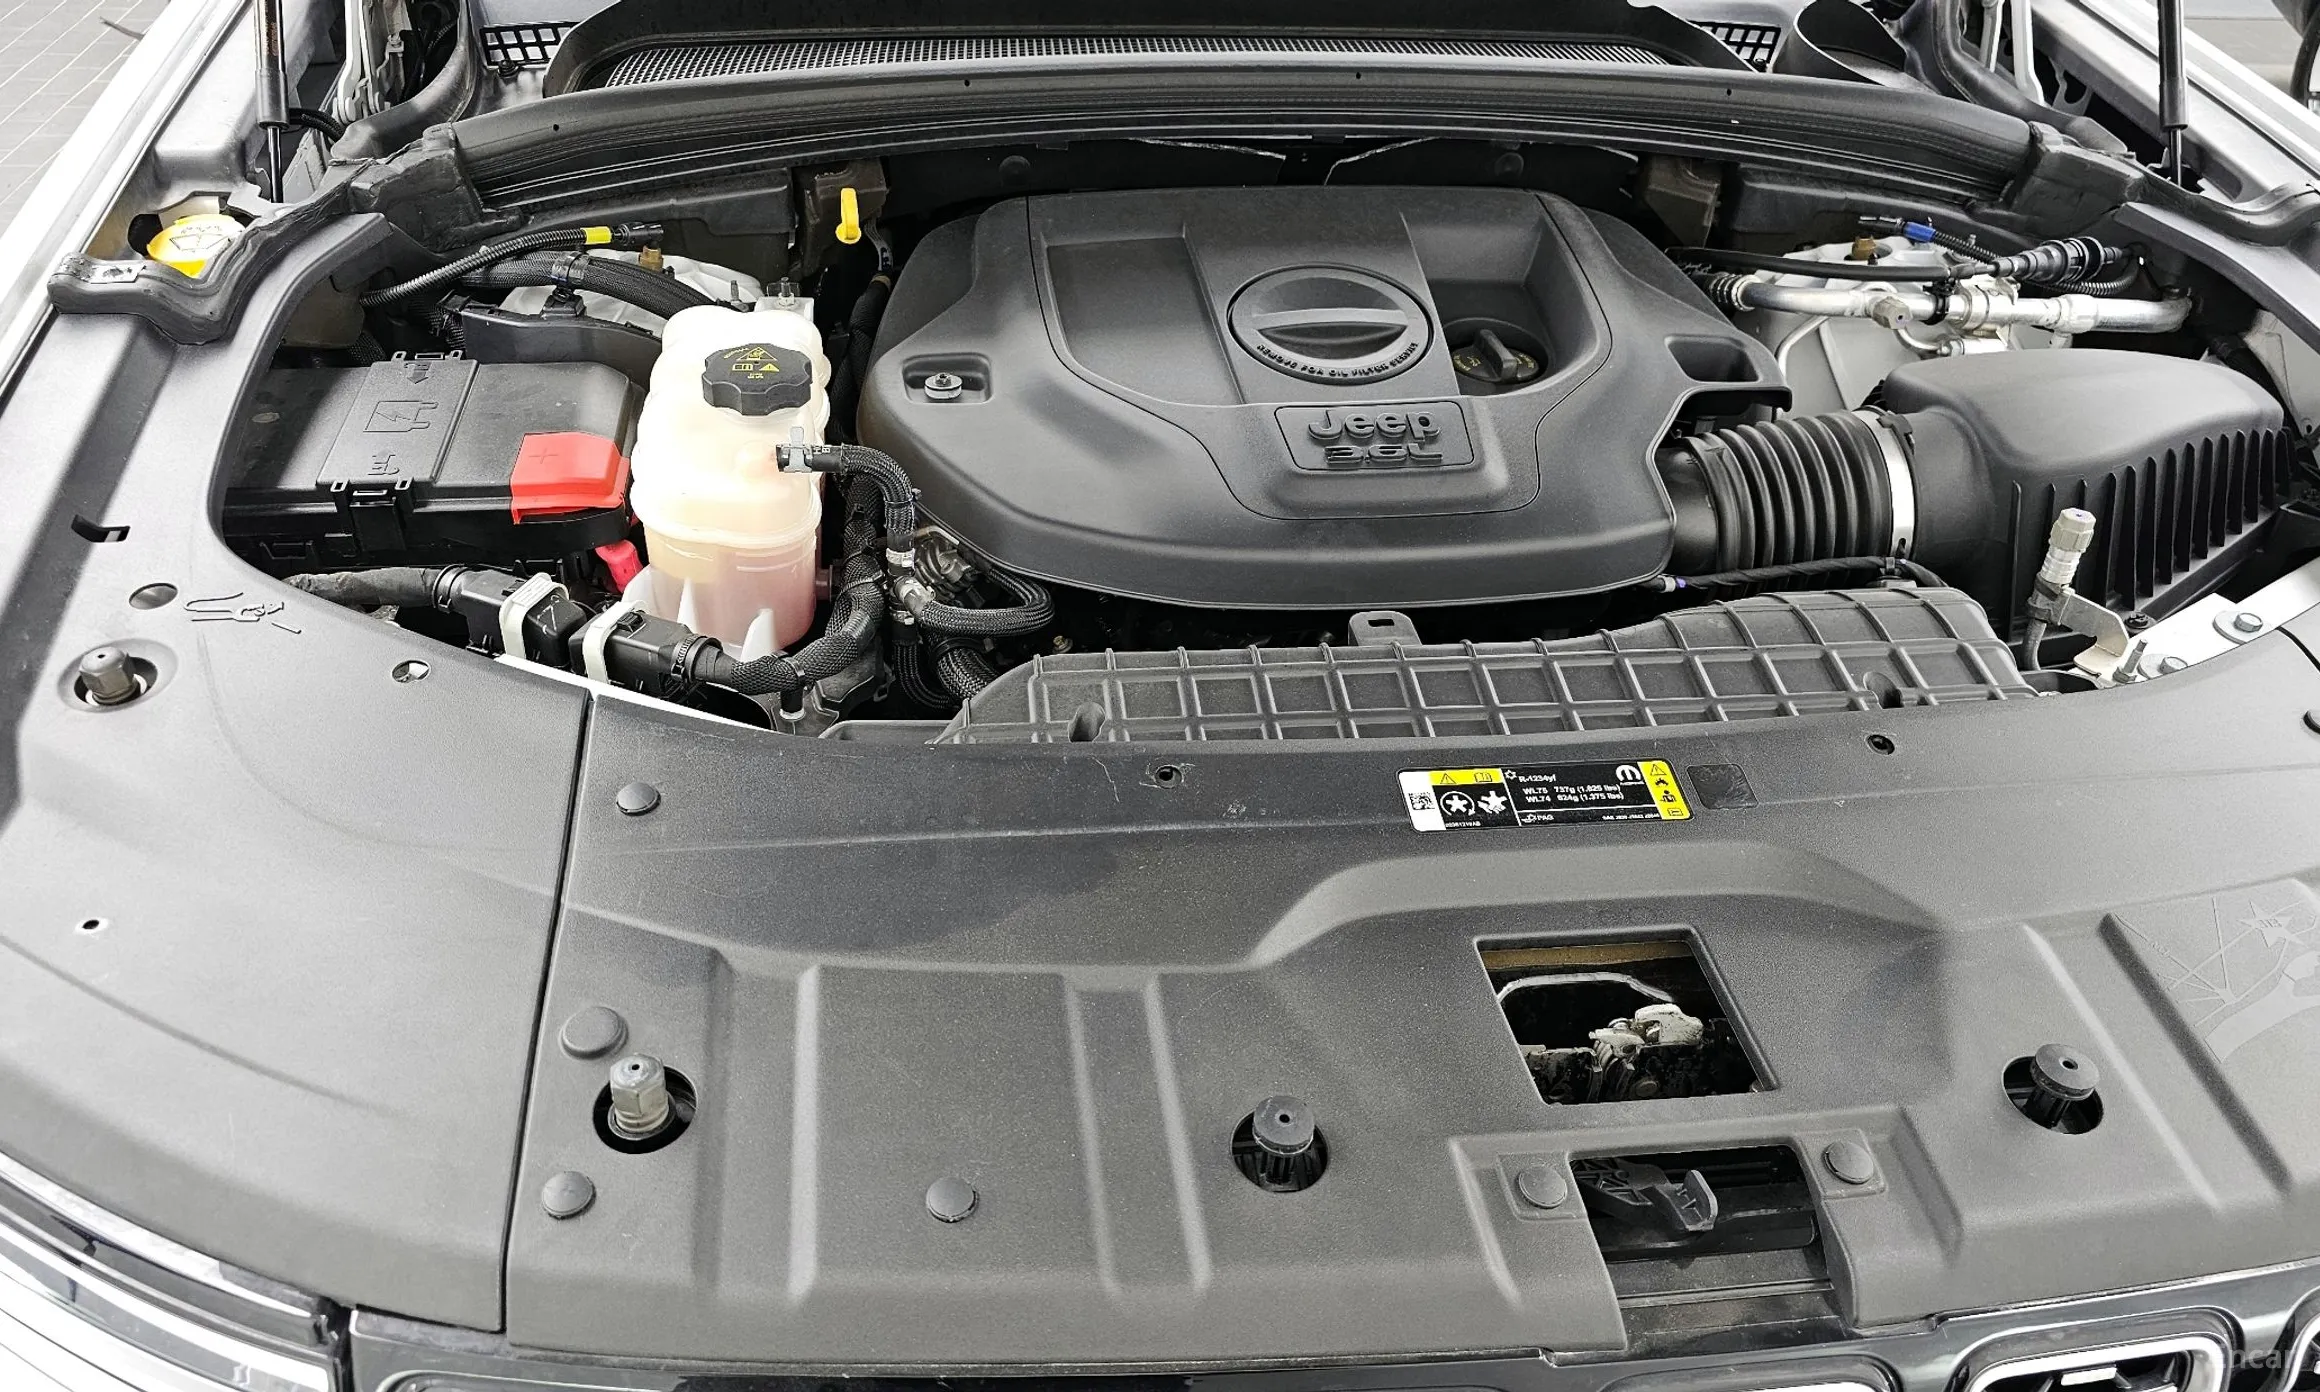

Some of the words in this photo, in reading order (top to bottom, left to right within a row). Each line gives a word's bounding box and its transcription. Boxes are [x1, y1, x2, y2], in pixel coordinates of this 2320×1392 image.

[1328, 369, 1349, 378] OIL
[1308, 409, 1441, 442] Jeep
[1525, 794, 1552, 803] WL74
